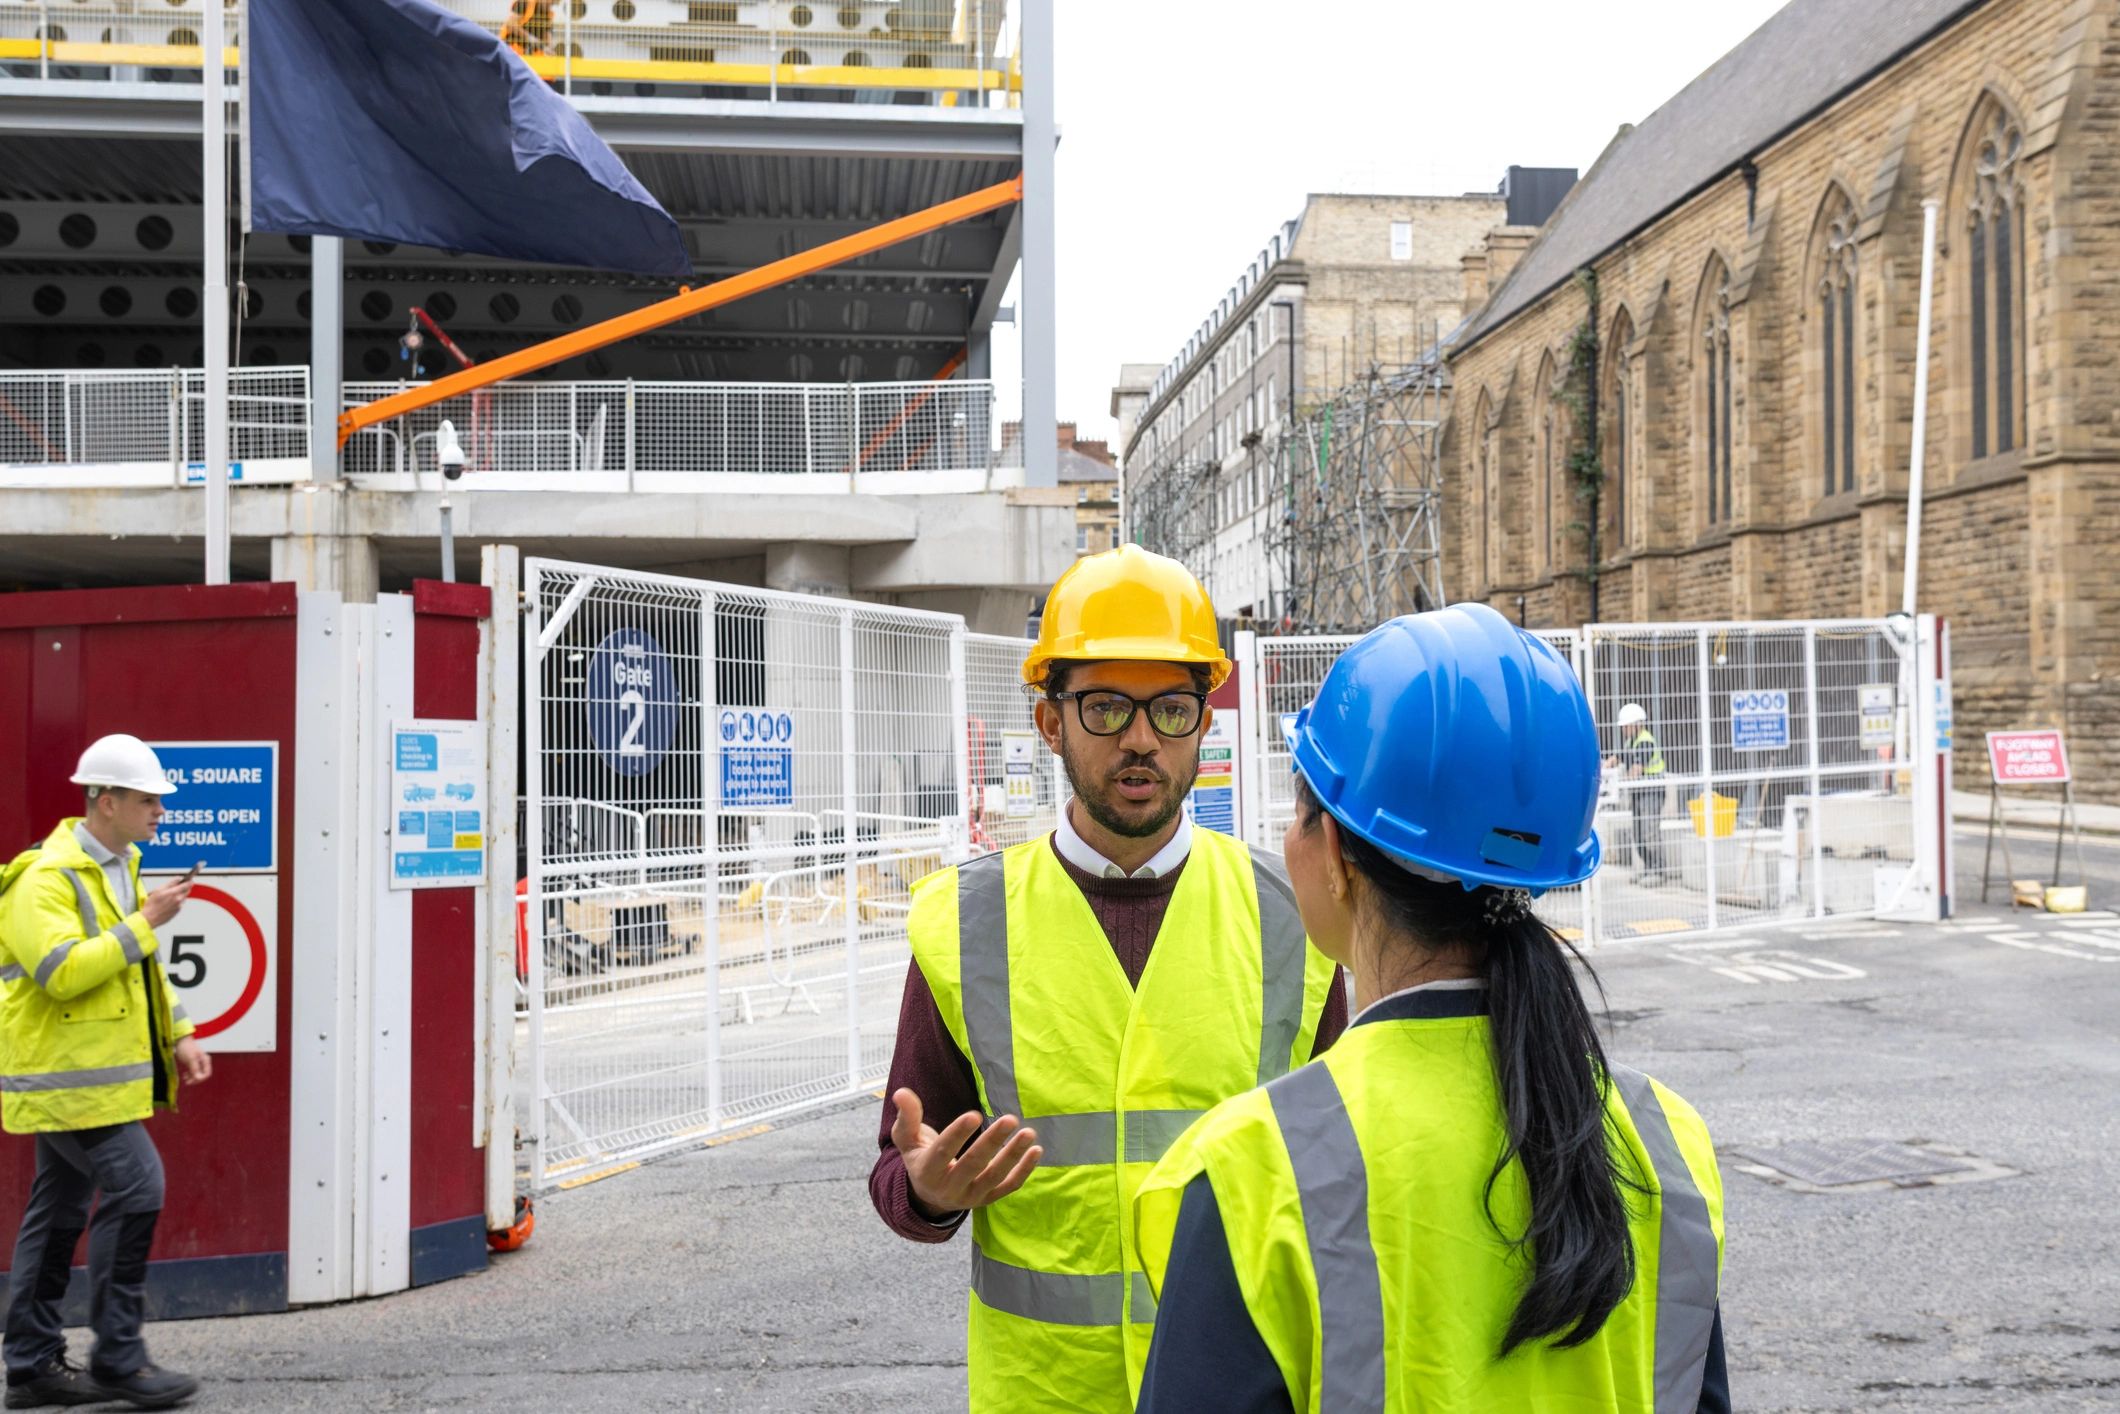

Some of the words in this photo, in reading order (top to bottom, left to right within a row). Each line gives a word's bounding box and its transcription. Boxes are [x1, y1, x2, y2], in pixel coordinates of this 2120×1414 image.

[614, 661, 653, 687] Gate
[620, 690, 645, 756] 2
[1205, 750, 1228, 760] SAFETY
[161, 768, 189, 784] OL
[192, 768, 262, 784] SQUARE
[2005, 763, 2057, 776] CLOSED
[217, 809, 260, 823] OPEN
[149, 832, 171, 846] AS
[174, 831, 227, 846] USUAL
[168, 935, 206, 989] 5
